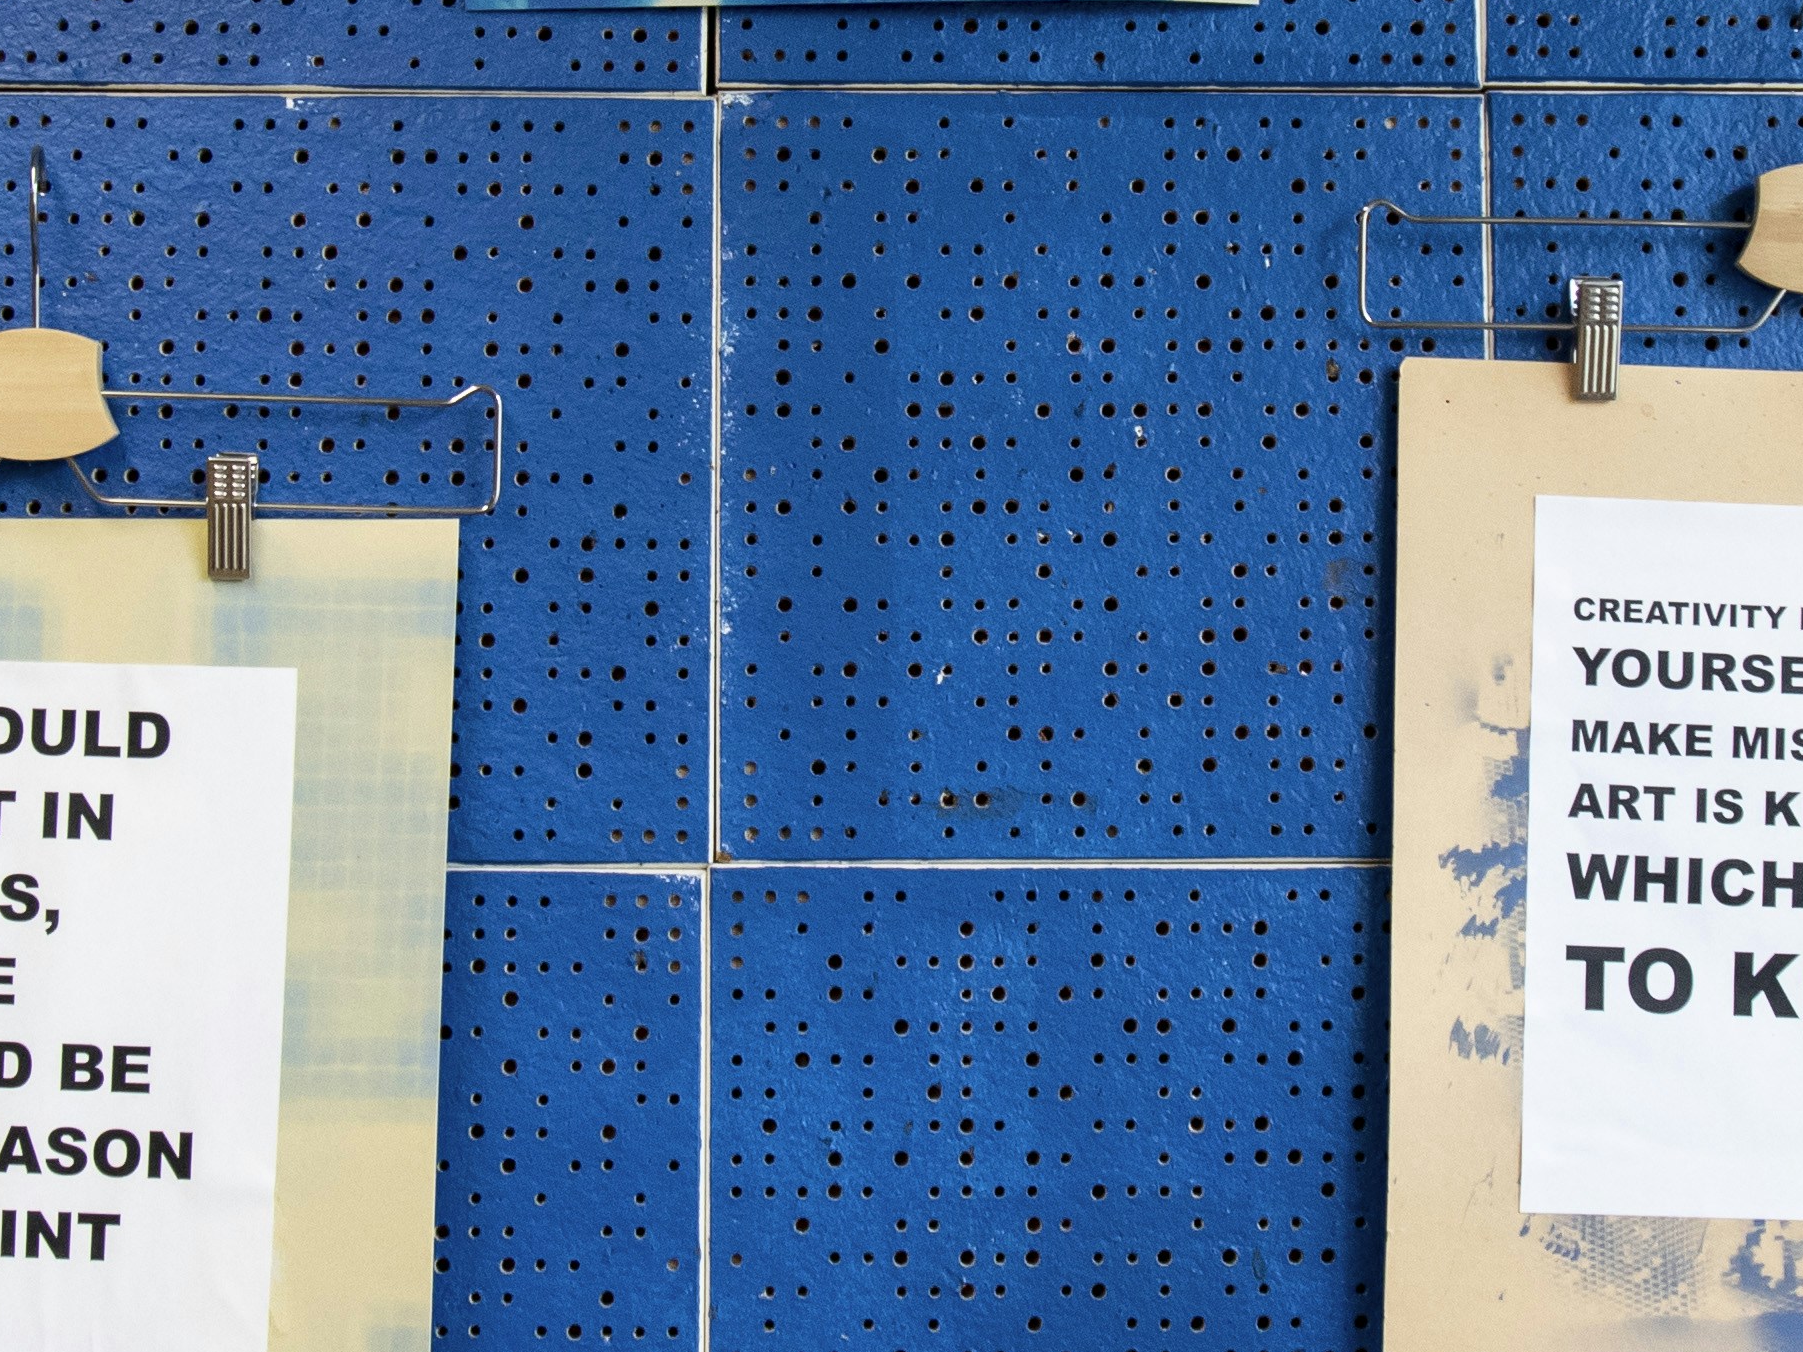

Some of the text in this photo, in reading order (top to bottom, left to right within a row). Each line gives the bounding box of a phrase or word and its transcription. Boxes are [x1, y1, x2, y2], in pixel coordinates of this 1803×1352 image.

[1574, 597, 1786, 629] CREATIVITY
[1572, 720, 1712, 757] MAKE
[43, 792, 113, 840] IN
[1568, 783, 1675, 821] ART
[1696, 788, 1743, 824] IS
[1566, 945, 1693, 1014] TO
[61, 1044, 151, 1093] BE
